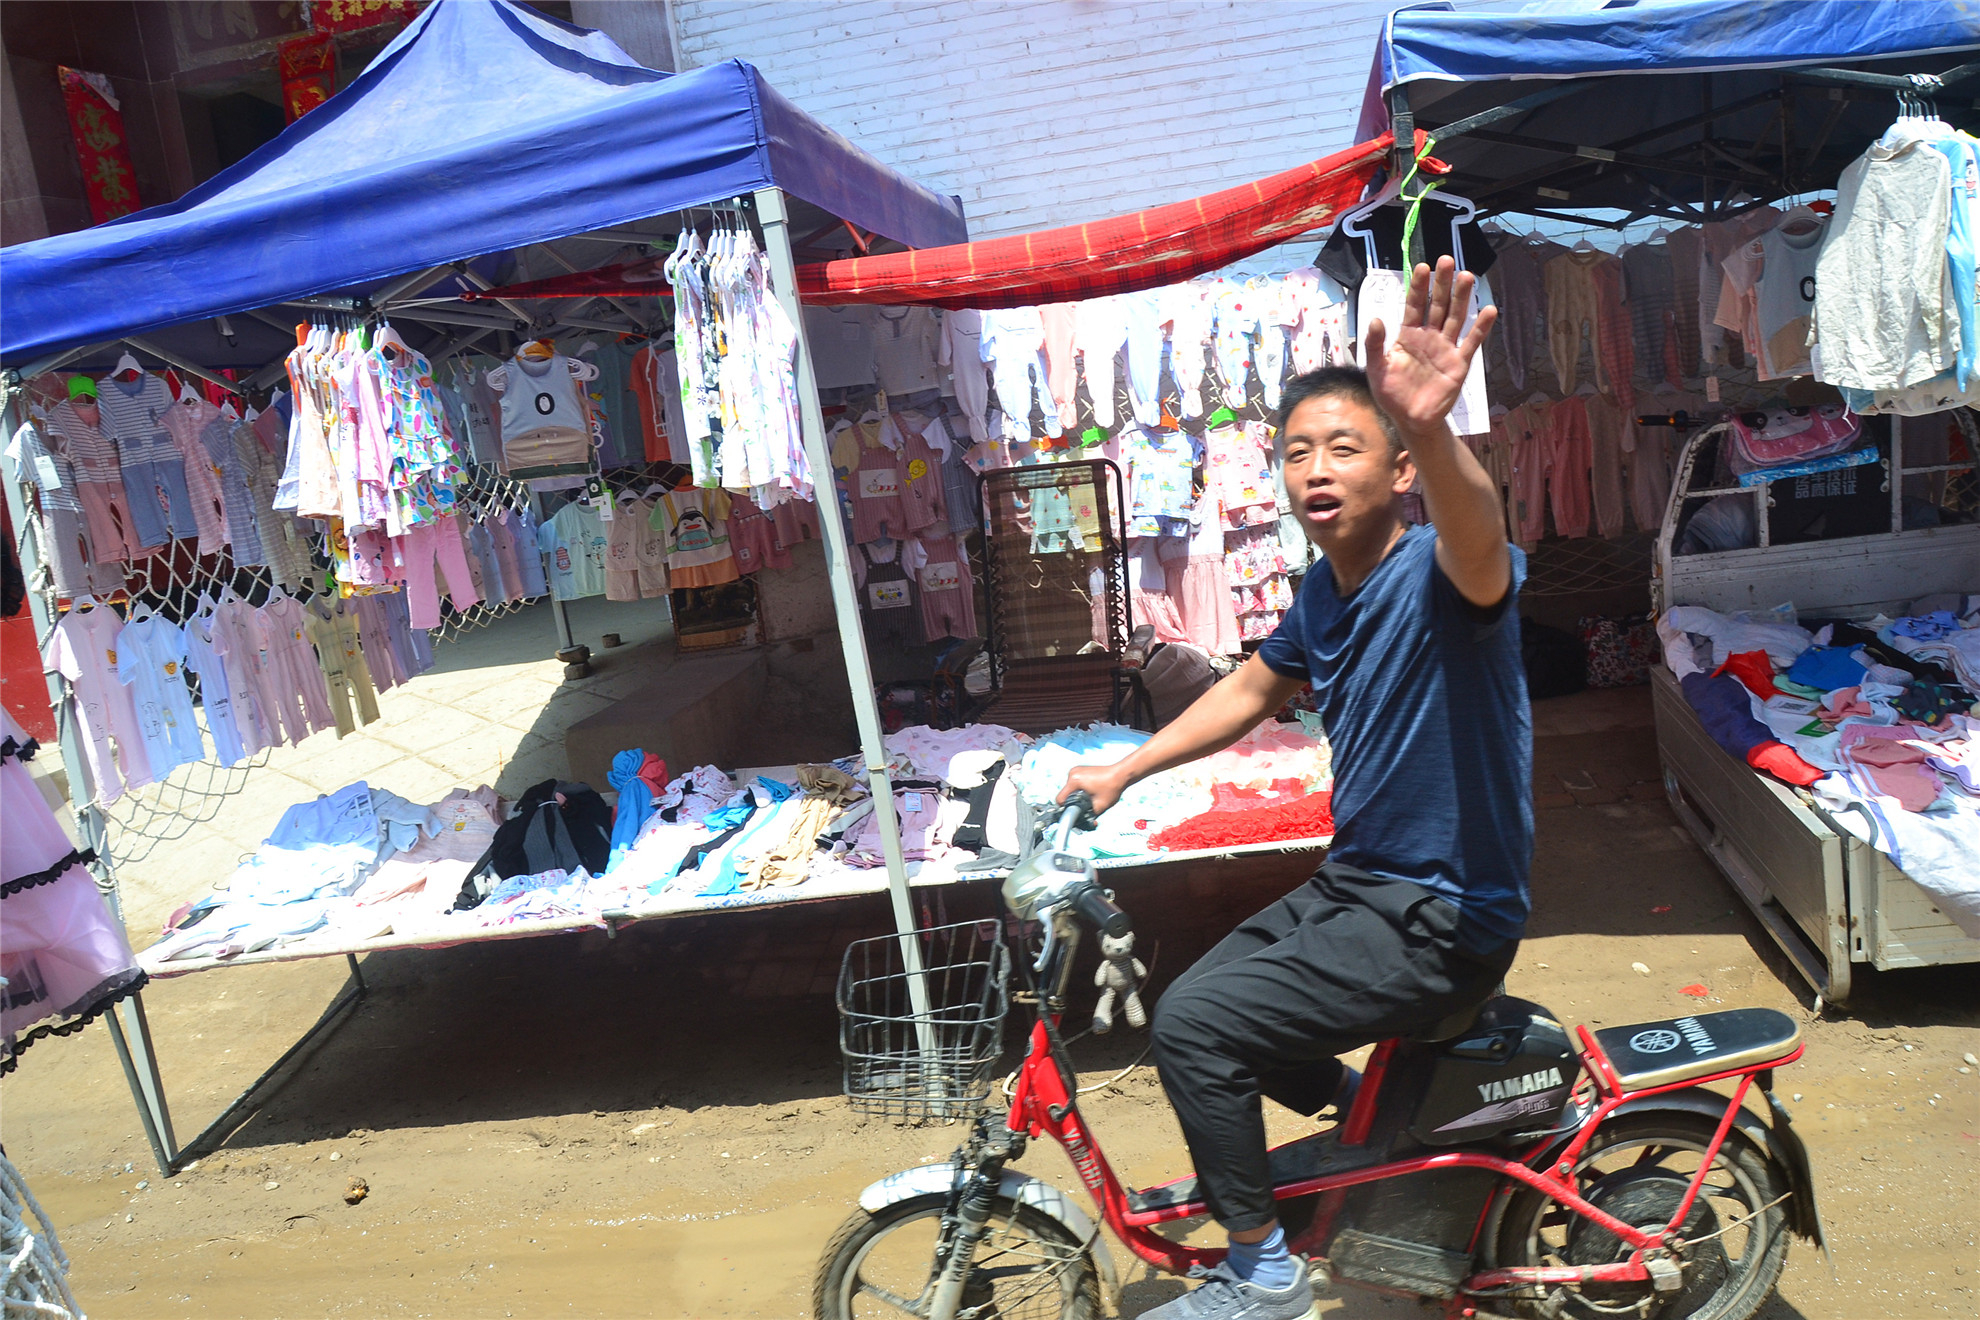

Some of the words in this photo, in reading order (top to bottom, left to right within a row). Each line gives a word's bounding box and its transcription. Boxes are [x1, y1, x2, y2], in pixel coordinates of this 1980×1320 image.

[1794, 480, 1857, 499] 品质保证
[1674, 1017, 1718, 1056] YAMAHA
[1477, 1066, 1563, 1103] YAMAHA
[1062, 1127, 1104, 1189] YAMAHA
